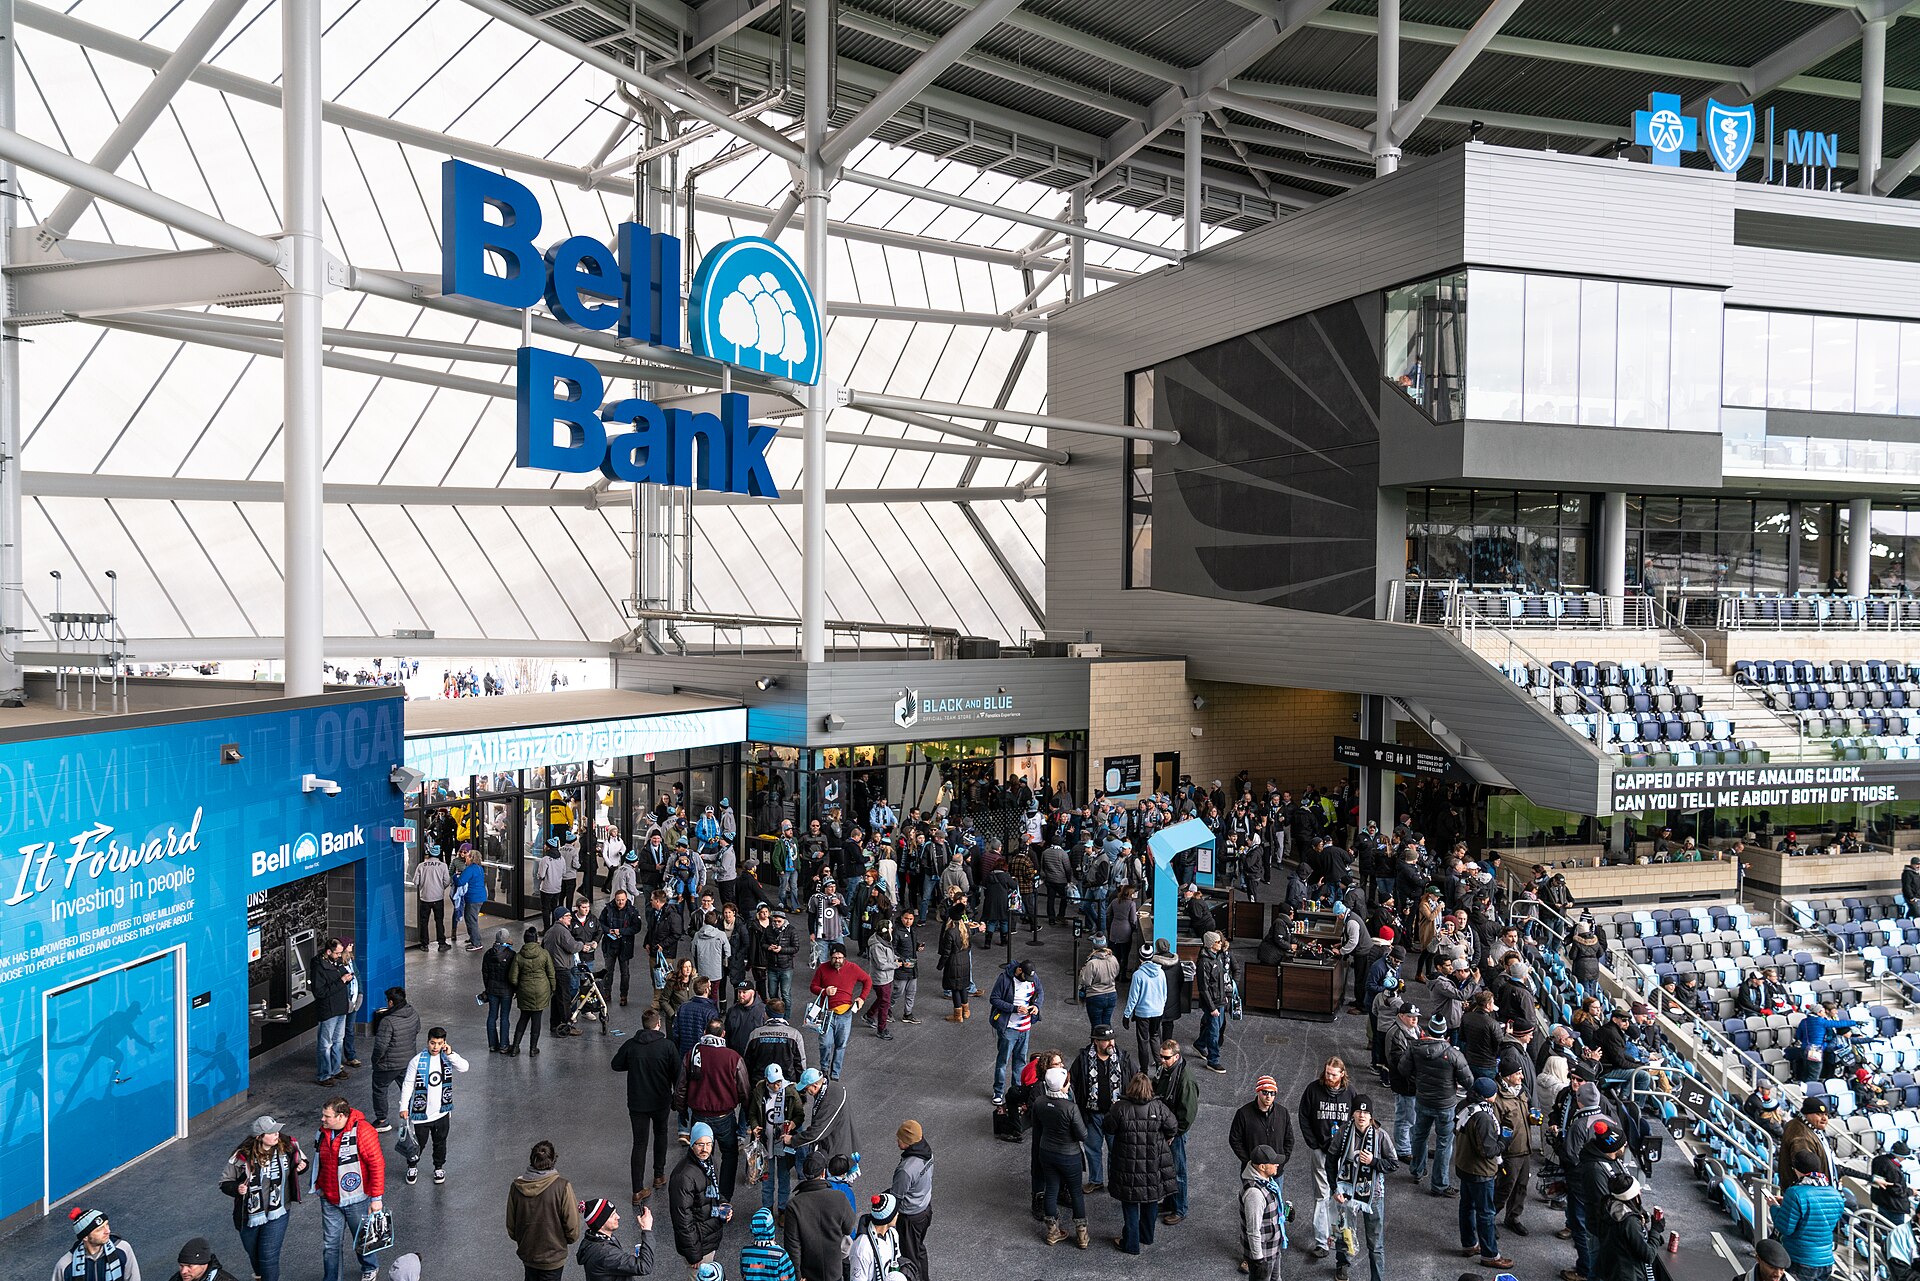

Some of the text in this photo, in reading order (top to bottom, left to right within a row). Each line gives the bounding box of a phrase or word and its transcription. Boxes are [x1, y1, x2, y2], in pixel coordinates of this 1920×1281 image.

[1785, 128, 1838, 168] MN
[442, 159, 681, 350] Bell
[516, 346, 780, 499] Bank
[923, 696, 1012, 712] BLACK AND BLUE
[469, 725, 626, 767] Allianz Field
[1614, 785, 1899, 811] CAN YOU TELL ME ABOUT BOTH OF THOSE.
[1615, 766, 1865, 790] CAPPED OFF BY THE ANALOG CLOCK.
[251, 824, 365, 878] Bell Bank
[396, 829, 411, 841] EXIT
[4, 806, 203, 906] It Forward
[51, 864, 195, 923] Investing in people
[12, 951, 29, 965] HAS
[30, 935, 78, 959] EMPOWERED
[79, 931, 91, 943] ITS
[92, 919, 131, 939] EMPLOYEES
[133, 916, 142, 926] TO
[143, 911, 157, 923] GIVE
[158, 902, 186, 918] MILLIONS
[186, 899, 195, 909] OF
[24, 963, 35, 975] TO
[37, 953, 66, 971] PEOPLE
[67, 950, 75, 961] IN
[76, 944, 95, 958] NEED
[96, 938, 111, 952] AND
[112, 930, 138, 946] CAUSES
[139, 923, 155, 937] THEY
[156, 919, 173, 932] CARE
[172, 912, 193, 926] ABOUT.
[1317, 1110, 1349, 1122] DAVIDSON
[1319, 1101, 1349, 1113] HARLEY-
[1688, 1091, 1705, 1105] 25
[1604, 1131, 1620, 1146] MN
